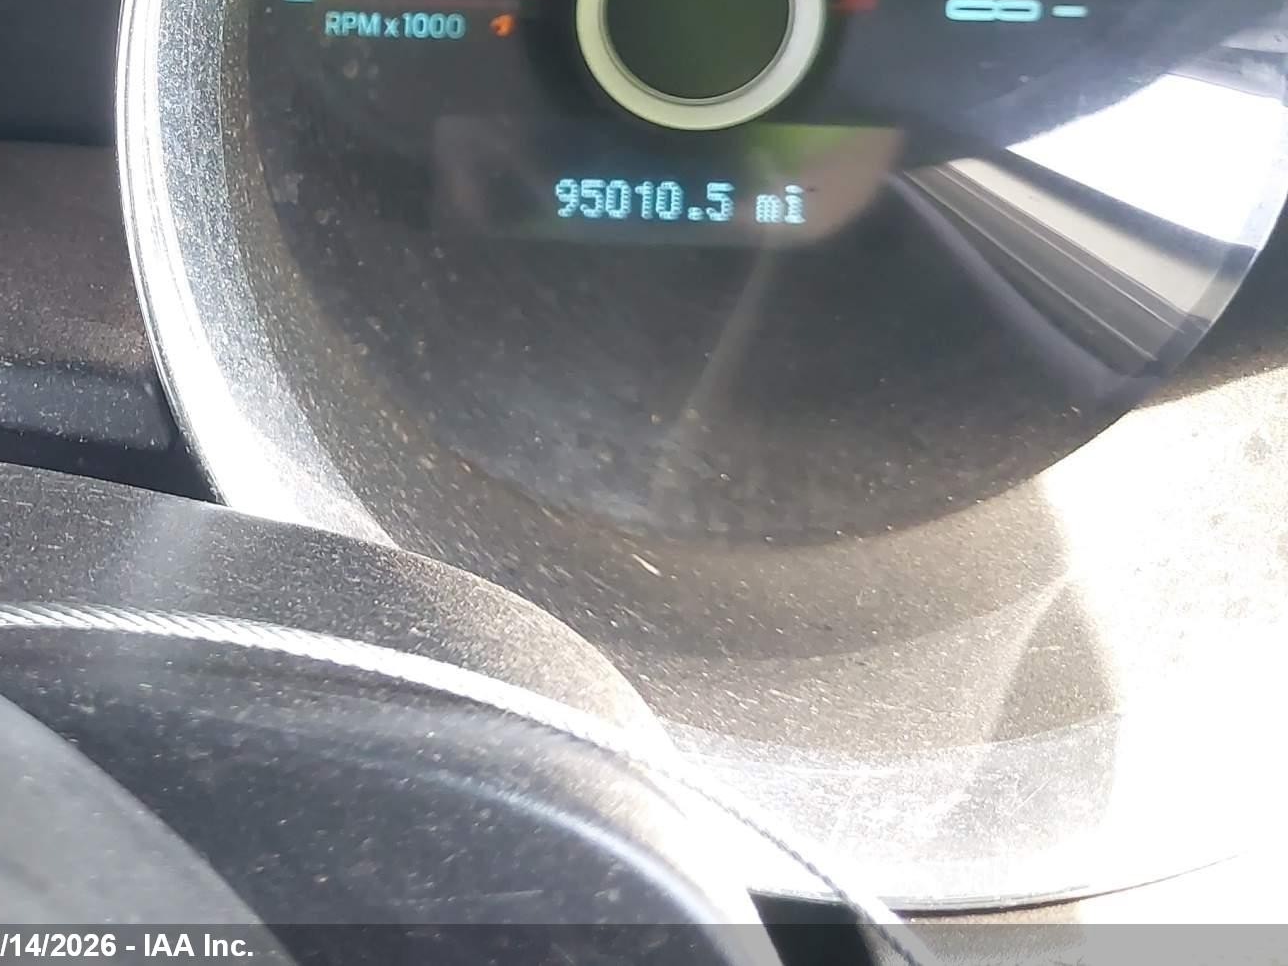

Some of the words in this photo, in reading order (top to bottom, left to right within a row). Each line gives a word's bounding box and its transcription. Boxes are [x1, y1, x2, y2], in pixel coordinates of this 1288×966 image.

[325, 10, 381, 37] RPM
[384, 17, 400, 37] x
[402, 12, 466, 39] 1000
[556, 178, 735, 222] 95010.5
[756, 185, 806, 224] mi
